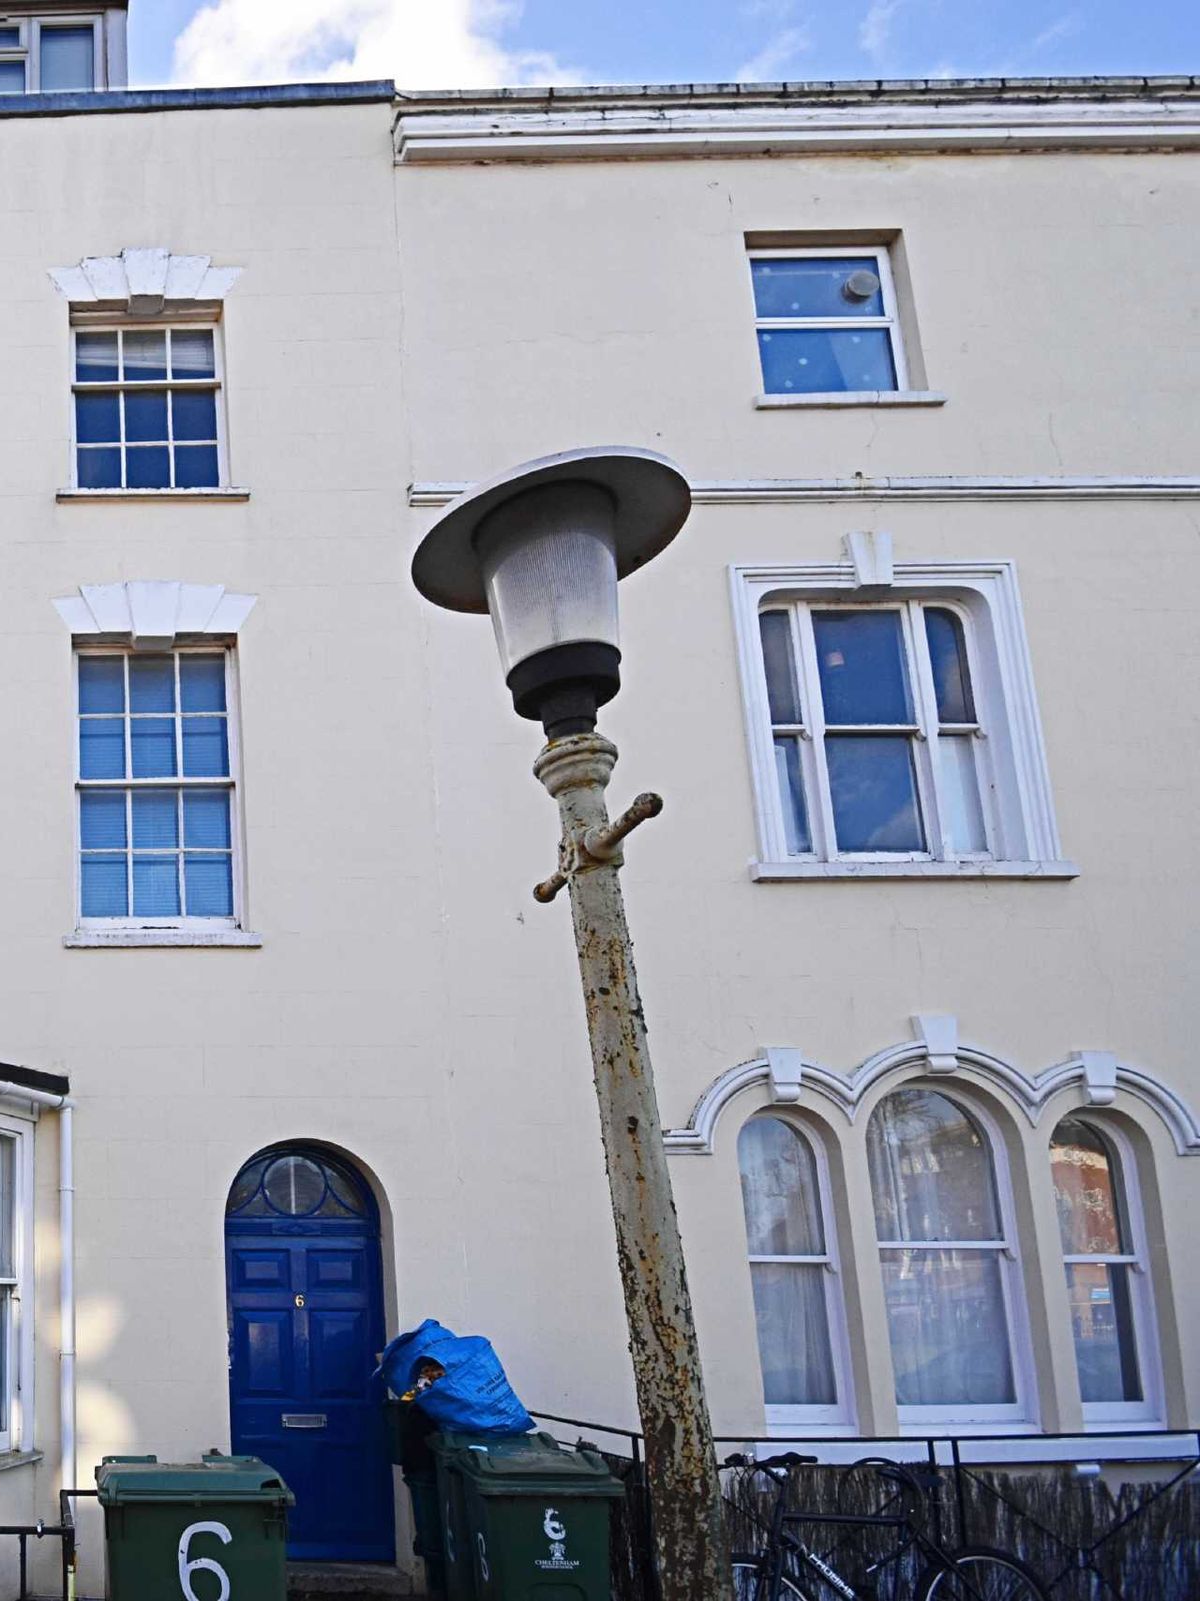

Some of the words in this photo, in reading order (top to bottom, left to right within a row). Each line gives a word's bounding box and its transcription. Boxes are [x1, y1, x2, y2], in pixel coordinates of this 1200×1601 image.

[295, 1295, 304, 1307] 6
[544, 1508, 566, 1541] 6
[178, 1521, 233, 1601] 6
[809, 1553, 856, 1599] PROBIKE
